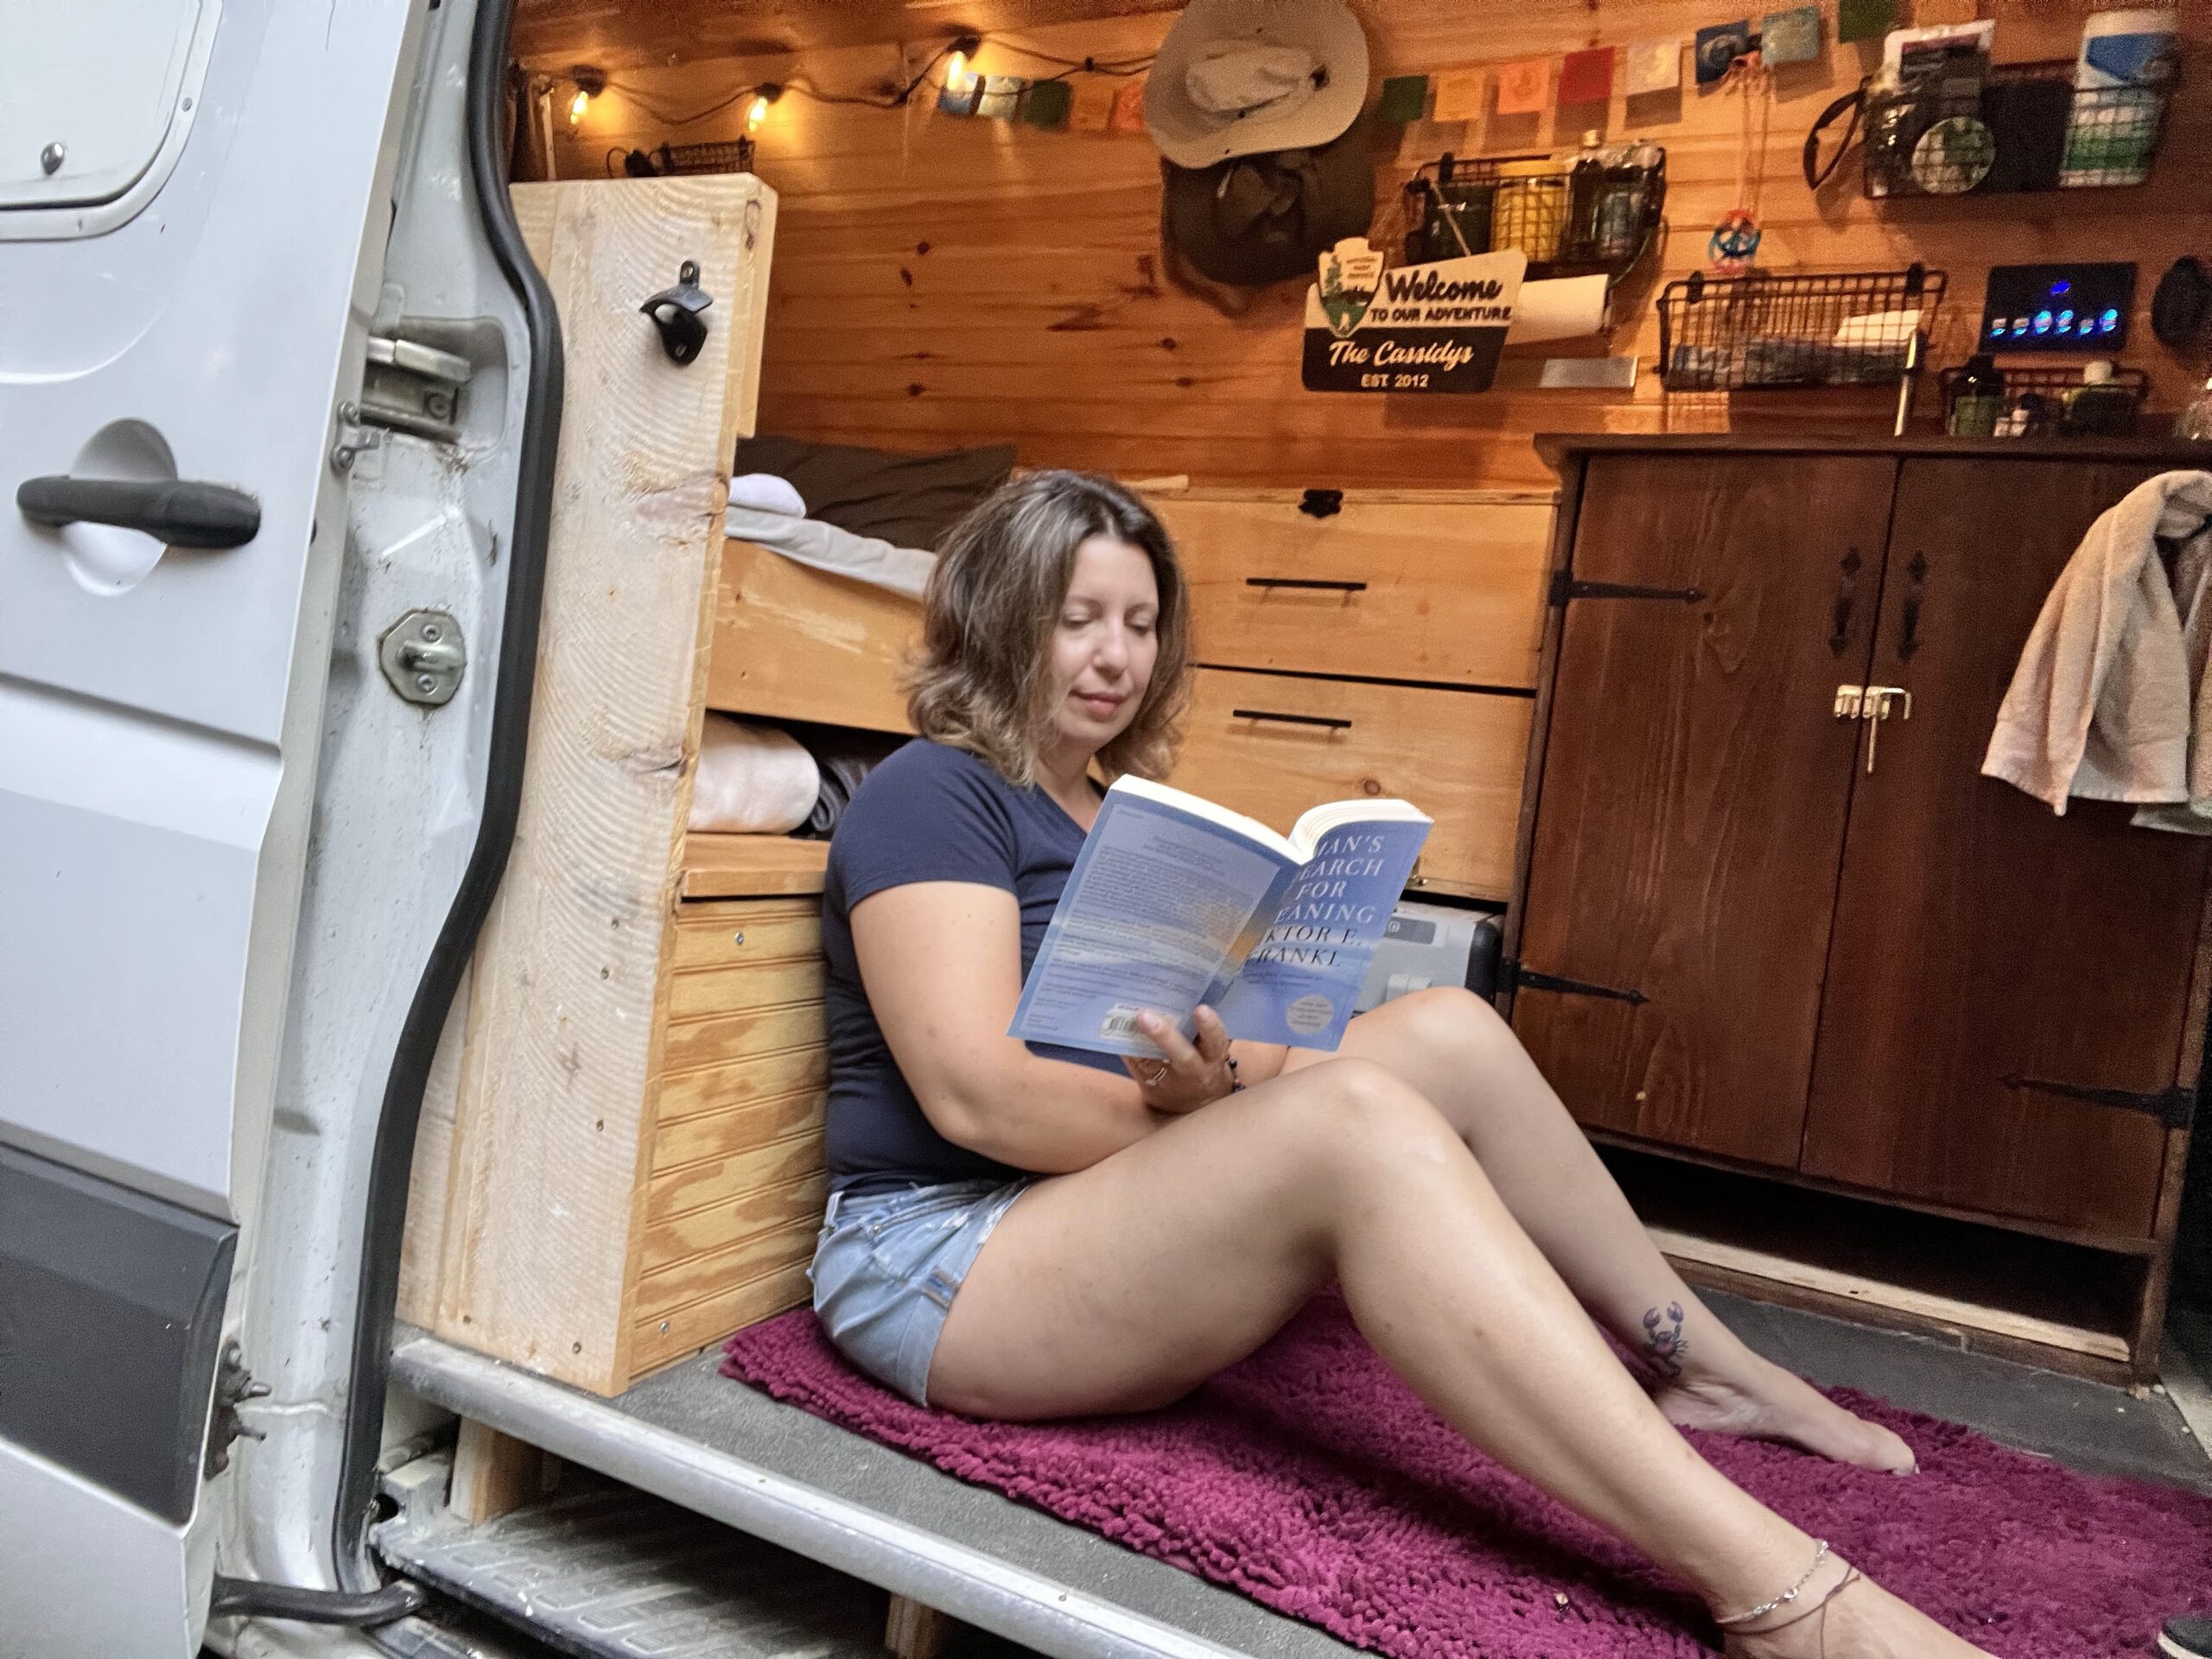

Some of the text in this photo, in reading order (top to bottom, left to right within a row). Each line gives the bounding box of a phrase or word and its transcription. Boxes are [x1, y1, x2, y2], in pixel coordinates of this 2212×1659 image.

[1385, 270, 1503, 302] Welcome
[1371, 307, 1511, 321] TO OUR ADVENTURE
[1329, 340, 1474, 372] The Cassidys
[1395, 373, 1429, 388] 2012
[1296, 858, 1385, 880] EARCH
[1296, 880, 1347, 900] FOR
[1274, 902, 1376, 925] EANING
[1265, 925, 1331, 944] KTOR
